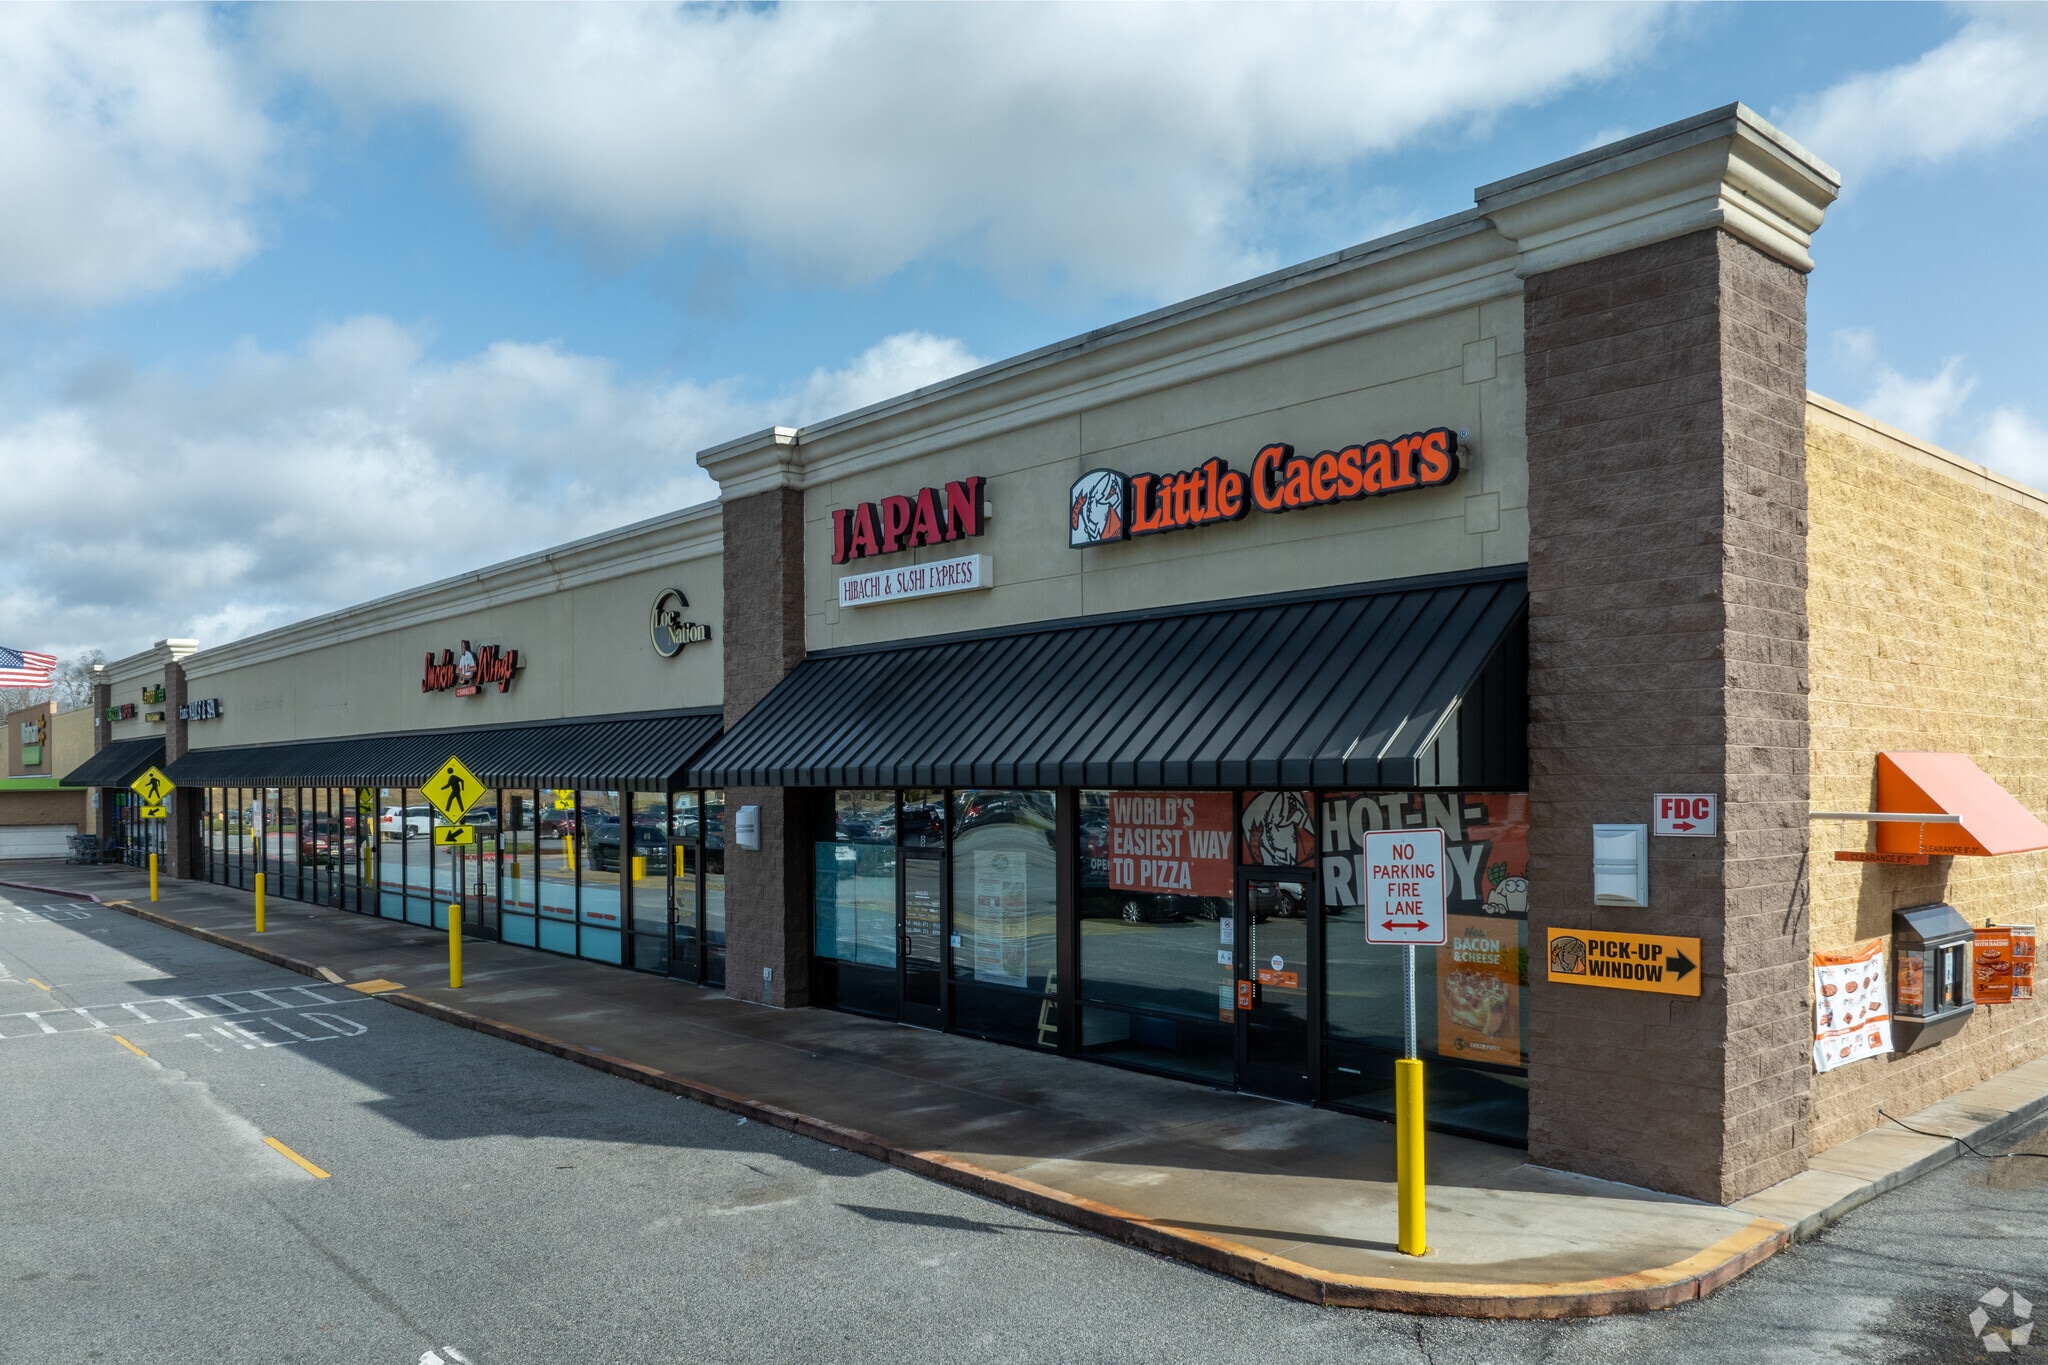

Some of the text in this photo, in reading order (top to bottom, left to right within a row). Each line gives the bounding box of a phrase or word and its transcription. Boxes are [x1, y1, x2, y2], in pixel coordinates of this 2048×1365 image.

[1131, 431, 1449, 533] Little Caesars
[832, 476, 979, 565] JAPAN
[843, 561, 973, 601] HIBACHI & SUSHI EXPRESS
[653, 609, 675, 628] Loc
[668, 622, 706, 645] Nation
[1113, 797, 1195, 827] WORLD'S
[1661, 798, 1710, 820] FDC
[1113, 828, 1233, 860] EASIEST WAY
[1392, 843, 1415, 861] NO
[1921, 845, 1962, 855] CLEARANCE
[1850, 853, 1896, 863] CLEARANCE
[1113, 858, 1192, 889] TO PIZZA
[1373, 864, 1435, 879] PARKING
[1388, 883, 1420, 897] FIRE
[1385, 901, 1424, 915] LANE
[1453, 937, 1500, 953] BACON
[1588, 940, 1663, 961] PICK-UP
[1588, 959, 1664, 982] WINDOW
